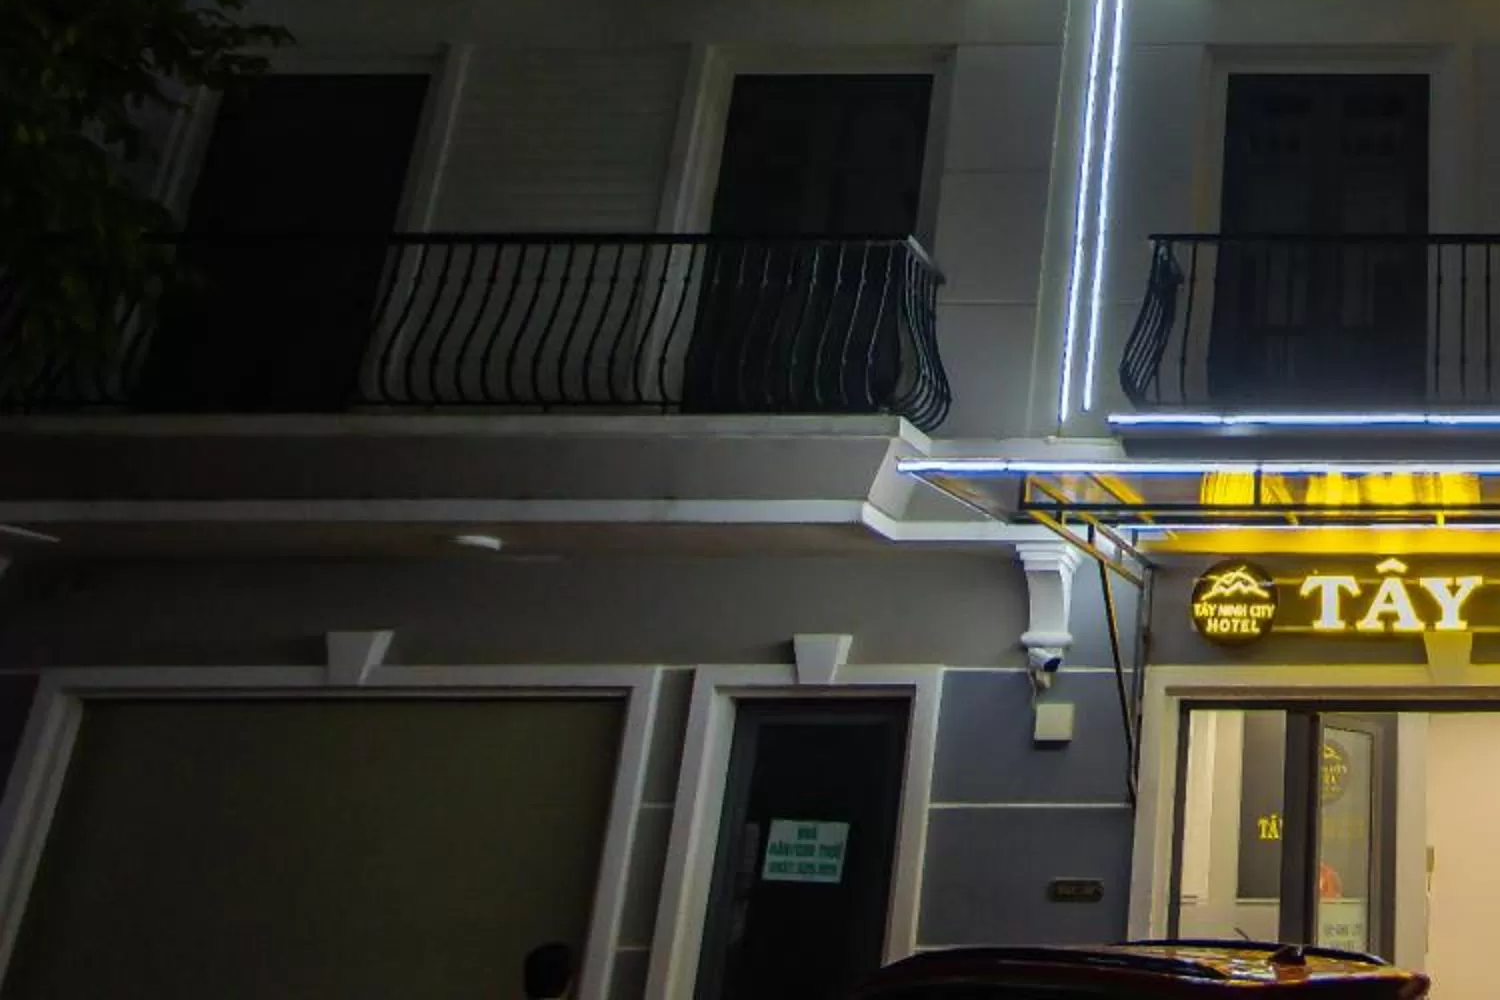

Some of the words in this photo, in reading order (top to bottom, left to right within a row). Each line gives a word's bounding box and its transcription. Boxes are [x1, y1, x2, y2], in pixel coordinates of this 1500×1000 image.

[1300, 557, 1484, 632] TÂY
[1218, 603, 1248, 617] NINH
[1249, 603, 1276, 618] CITY
[1206, 618, 1261, 634] HOTEL
